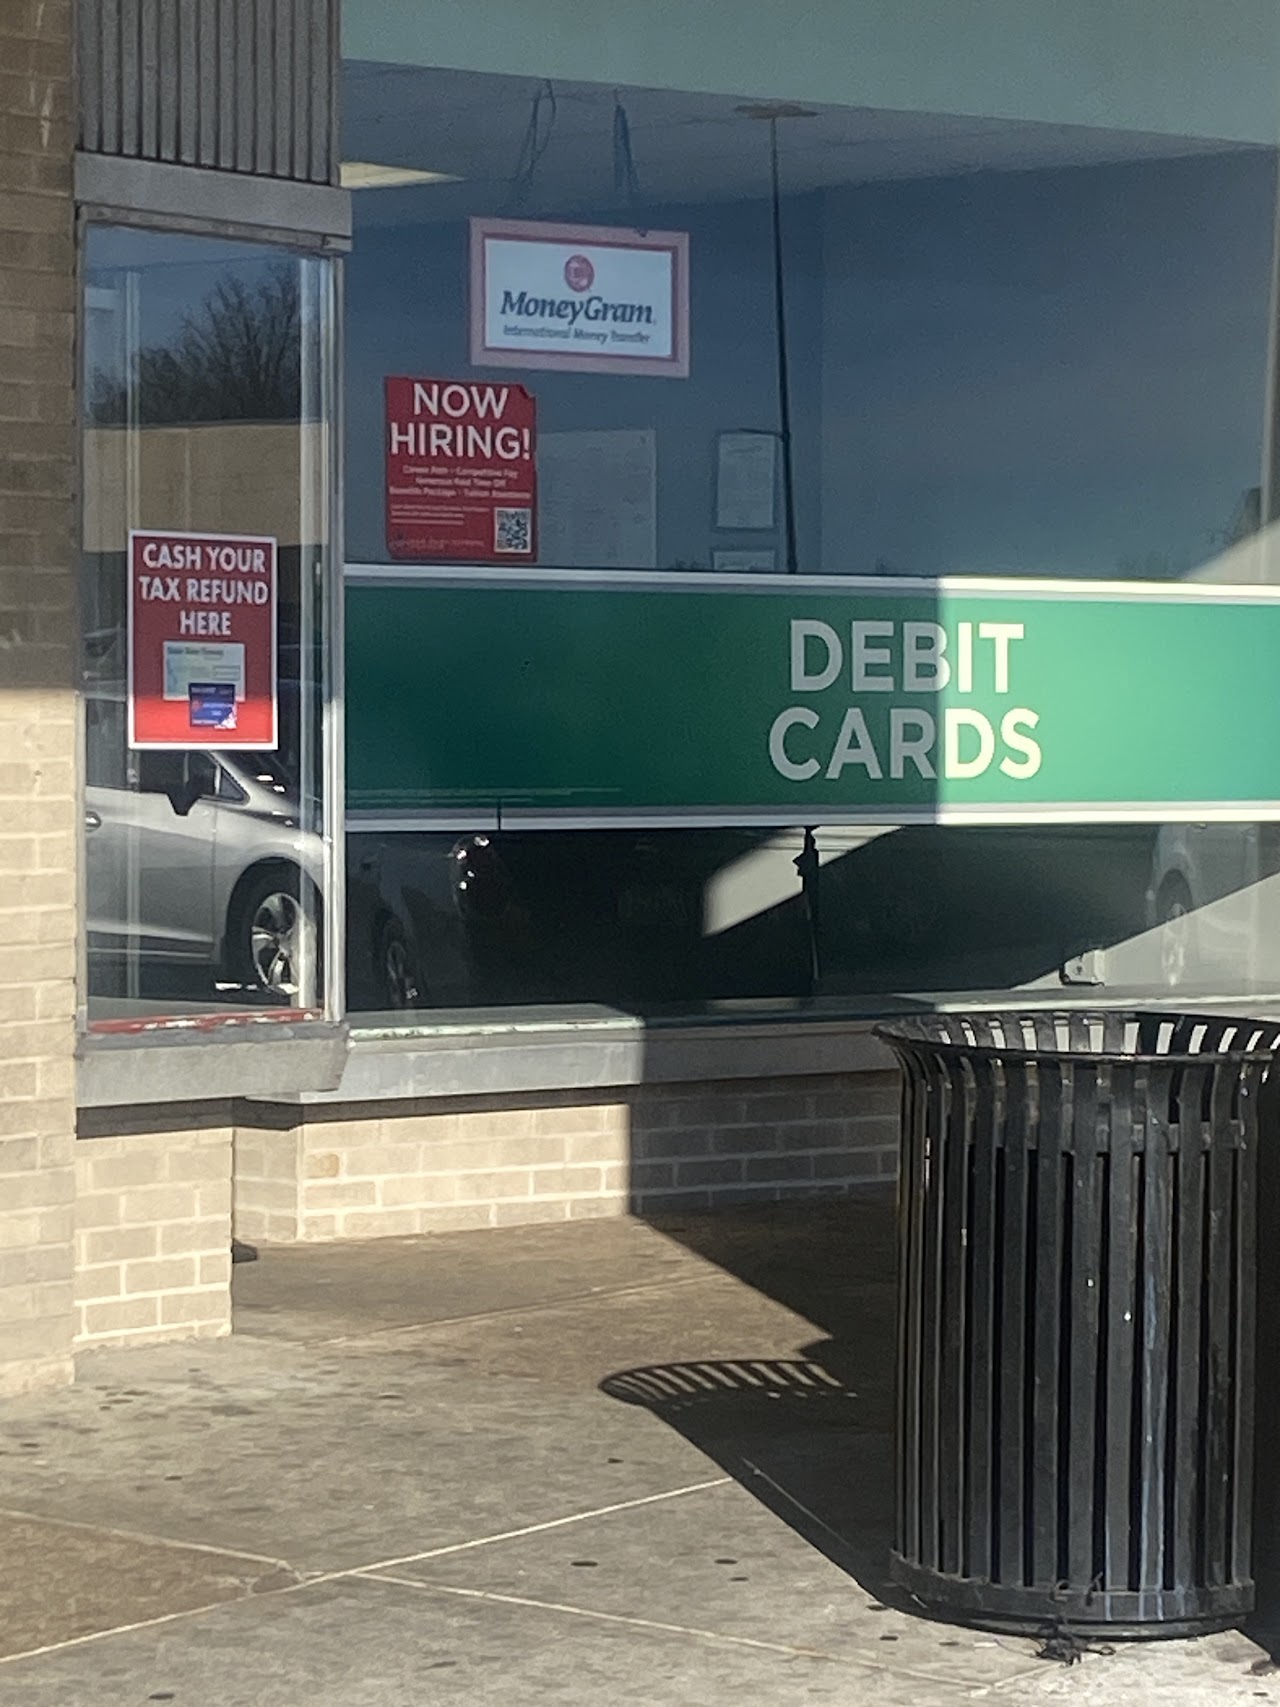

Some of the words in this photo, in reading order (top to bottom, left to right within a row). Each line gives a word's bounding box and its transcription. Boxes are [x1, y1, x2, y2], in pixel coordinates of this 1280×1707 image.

[500, 290, 653, 325] MoneyGram
[573, 327, 608, 345] Money
[413, 383, 509, 420] NOW
[391, 422, 531, 461] HIRING!
[142, 543, 201, 571] CASH
[206, 546, 266, 573] YOUR
[139, 576, 181, 601] TAX
[186, 578, 268, 604] REFUND
[179, 610, 232, 636] HERE
[790, 619, 1025, 694] DEBIT
[769, 706, 1042, 782] CARDS
